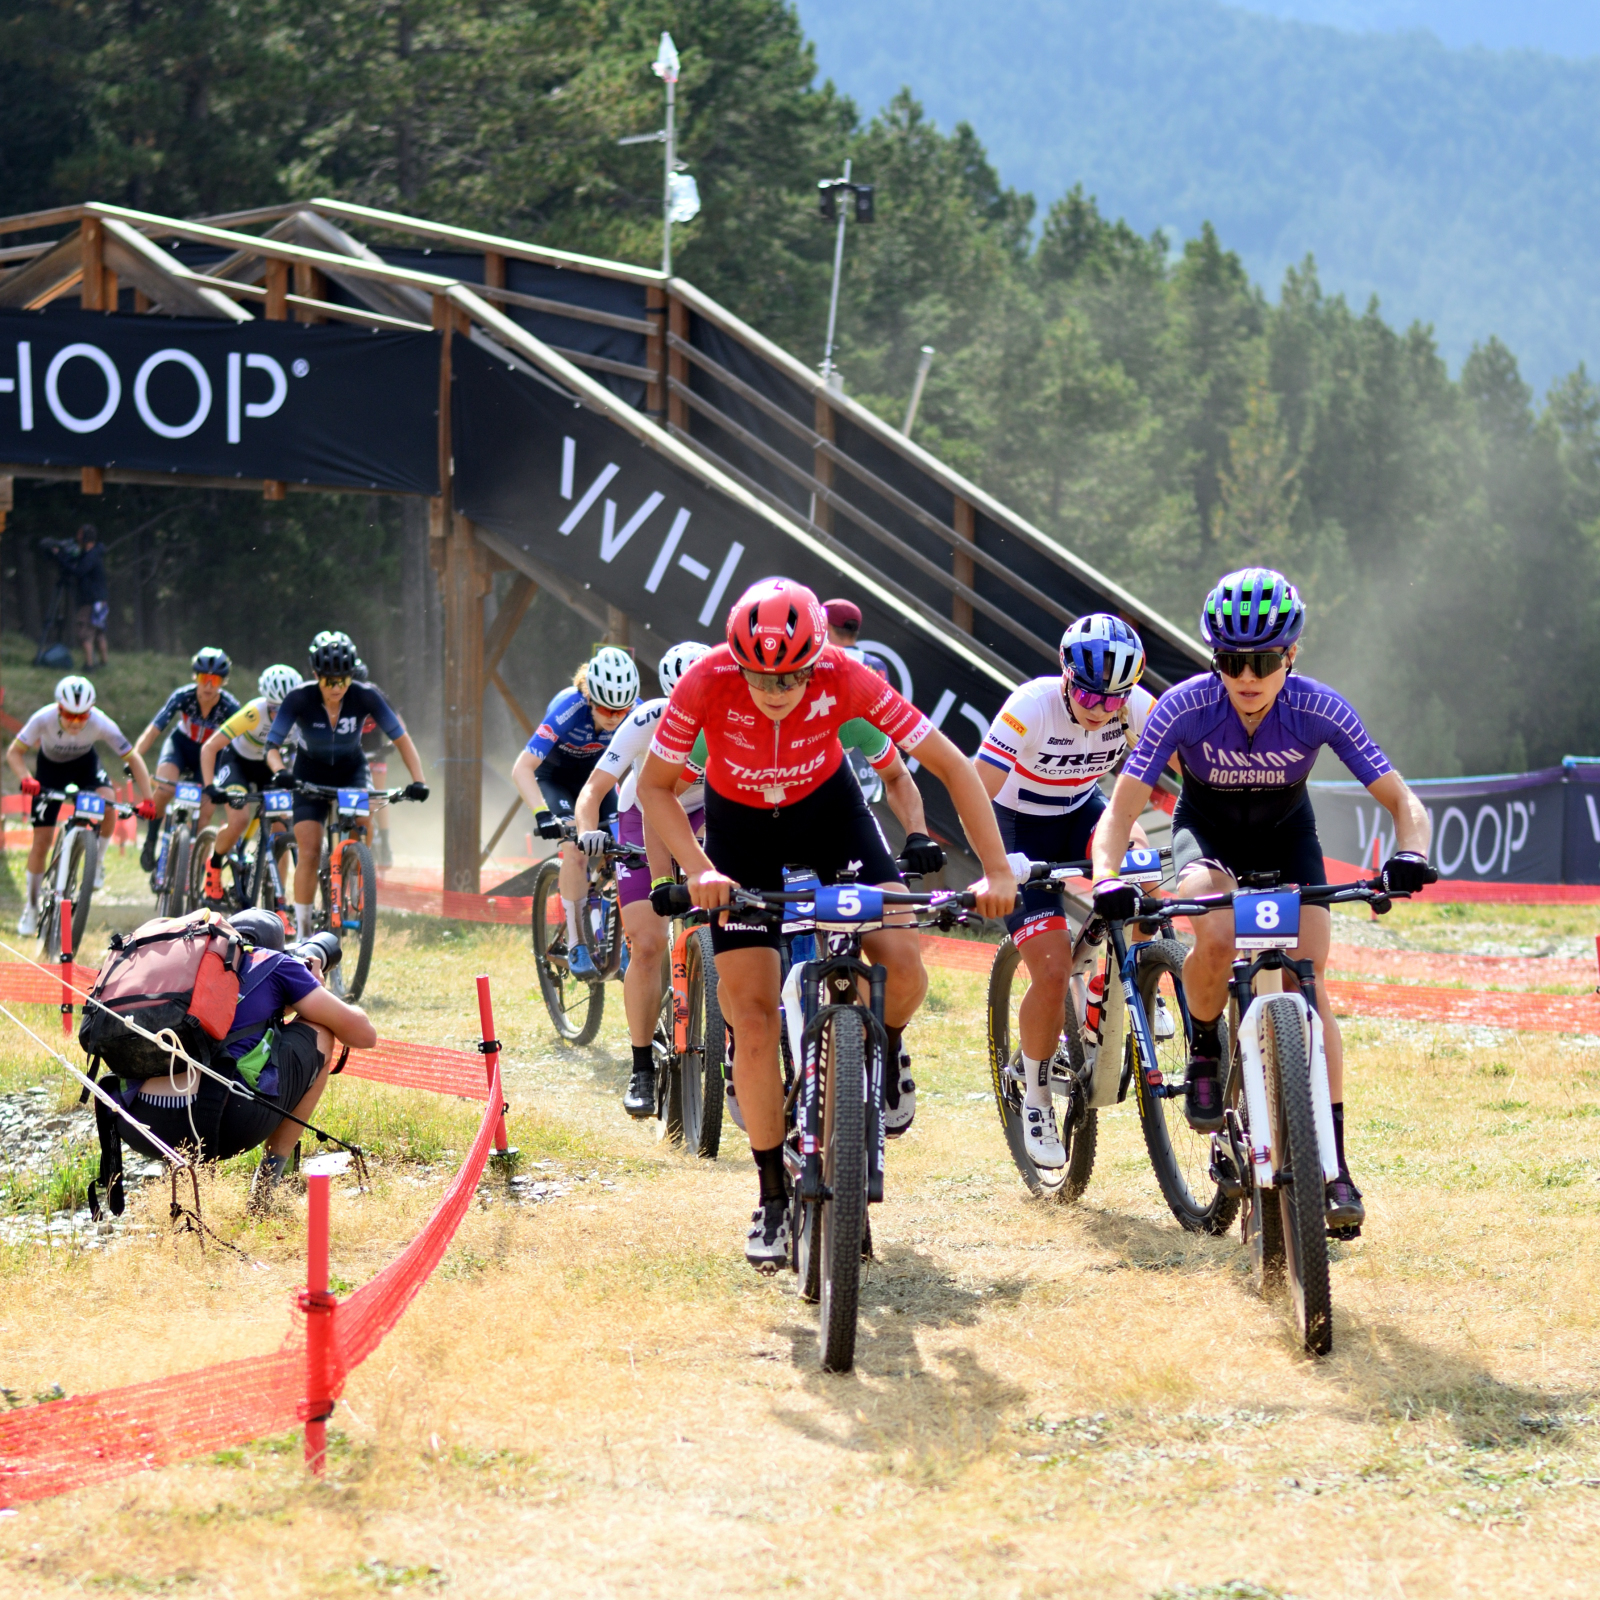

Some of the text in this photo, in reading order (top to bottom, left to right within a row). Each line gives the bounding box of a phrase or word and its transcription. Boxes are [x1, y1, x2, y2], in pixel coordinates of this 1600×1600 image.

[816, 661, 835, 670] axon
[869, 689, 894, 717] KPMG
[669, 705, 696, 726] KPMG
[791, 739, 806, 749] DT
[1046, 736, 1075, 746] Santini
[1101, 728, 1125, 743] ROCKSH
[1037, 742, 1127, 767] TREK
[1202, 741, 1306, 767] CANYON
[1209, 767, 1286, 784] ROCKSHOX
[179, 786, 199, 800] 20
[348, 794, 360, 807] 7
[81, 796, 101, 812] 11
[269, 795, 290, 810] 13
[1356, 801, 1530, 876] WOOP
[837, 890, 862, 916] 5
[1024, 910, 1055, 925] Santini
[1256, 900, 1280, 930] 8
[1014, 919, 1049, 946] EK
[990, 1035, 1002, 1098] PIRELLI
